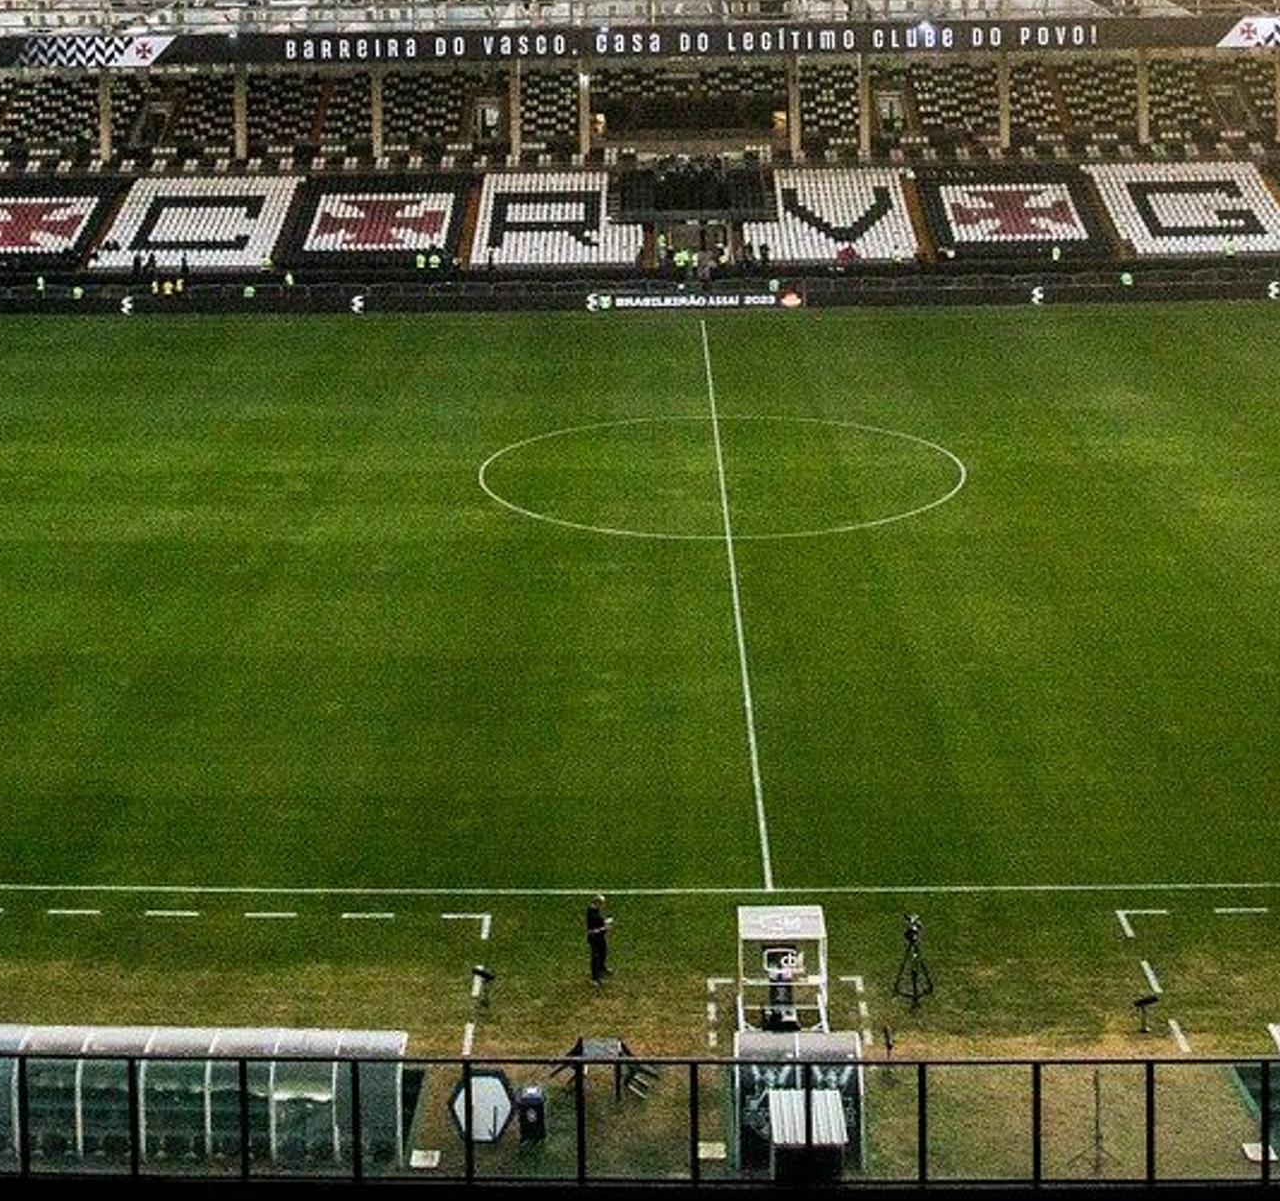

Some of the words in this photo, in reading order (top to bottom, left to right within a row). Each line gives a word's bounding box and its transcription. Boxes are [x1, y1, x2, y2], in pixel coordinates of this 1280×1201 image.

[435, 36, 465, 56] DO
[680, 31, 709, 52] DO
[972, 26, 1001, 47] DO
[1020, 24, 1098, 46] POVO!
